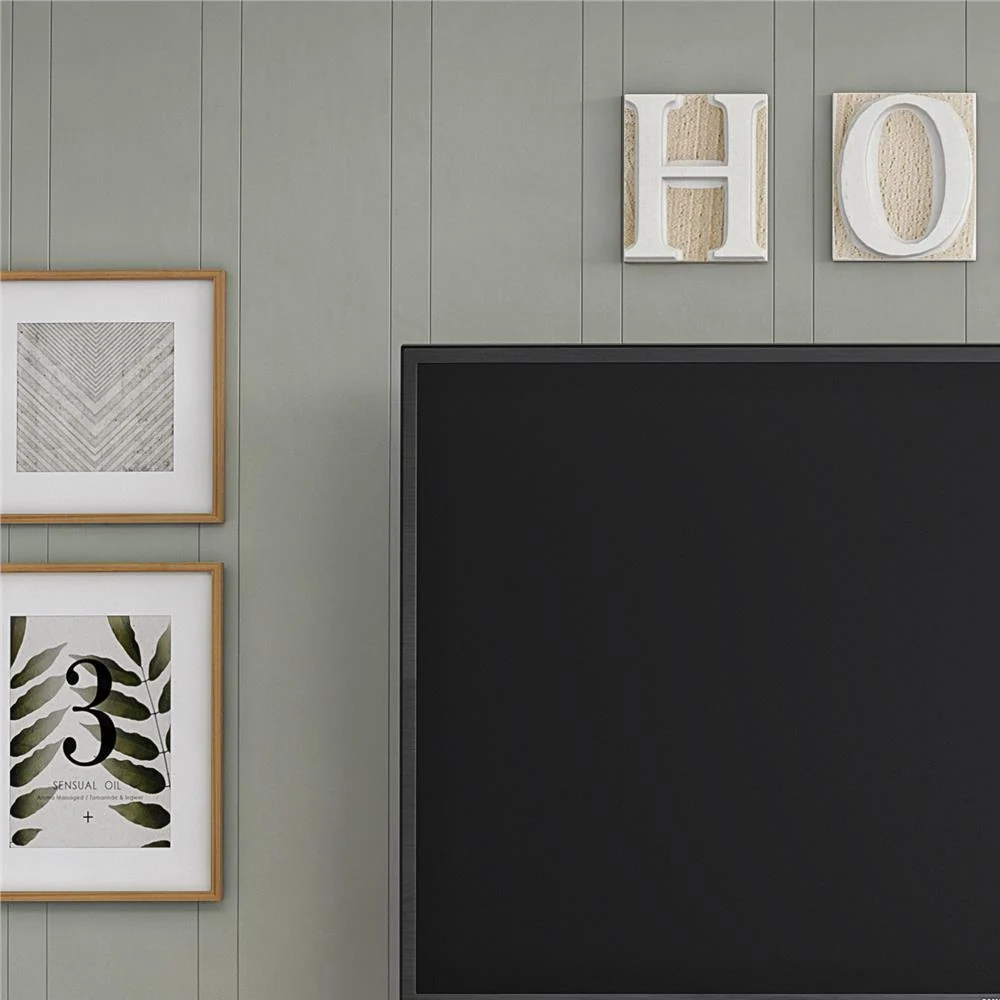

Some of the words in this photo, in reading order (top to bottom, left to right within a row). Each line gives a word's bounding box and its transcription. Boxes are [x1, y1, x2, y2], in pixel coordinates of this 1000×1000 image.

[62, 658, 117, 767] 3
[52, 780, 97, 791] SENSUAL
[104, 780, 122, 791] OIL
